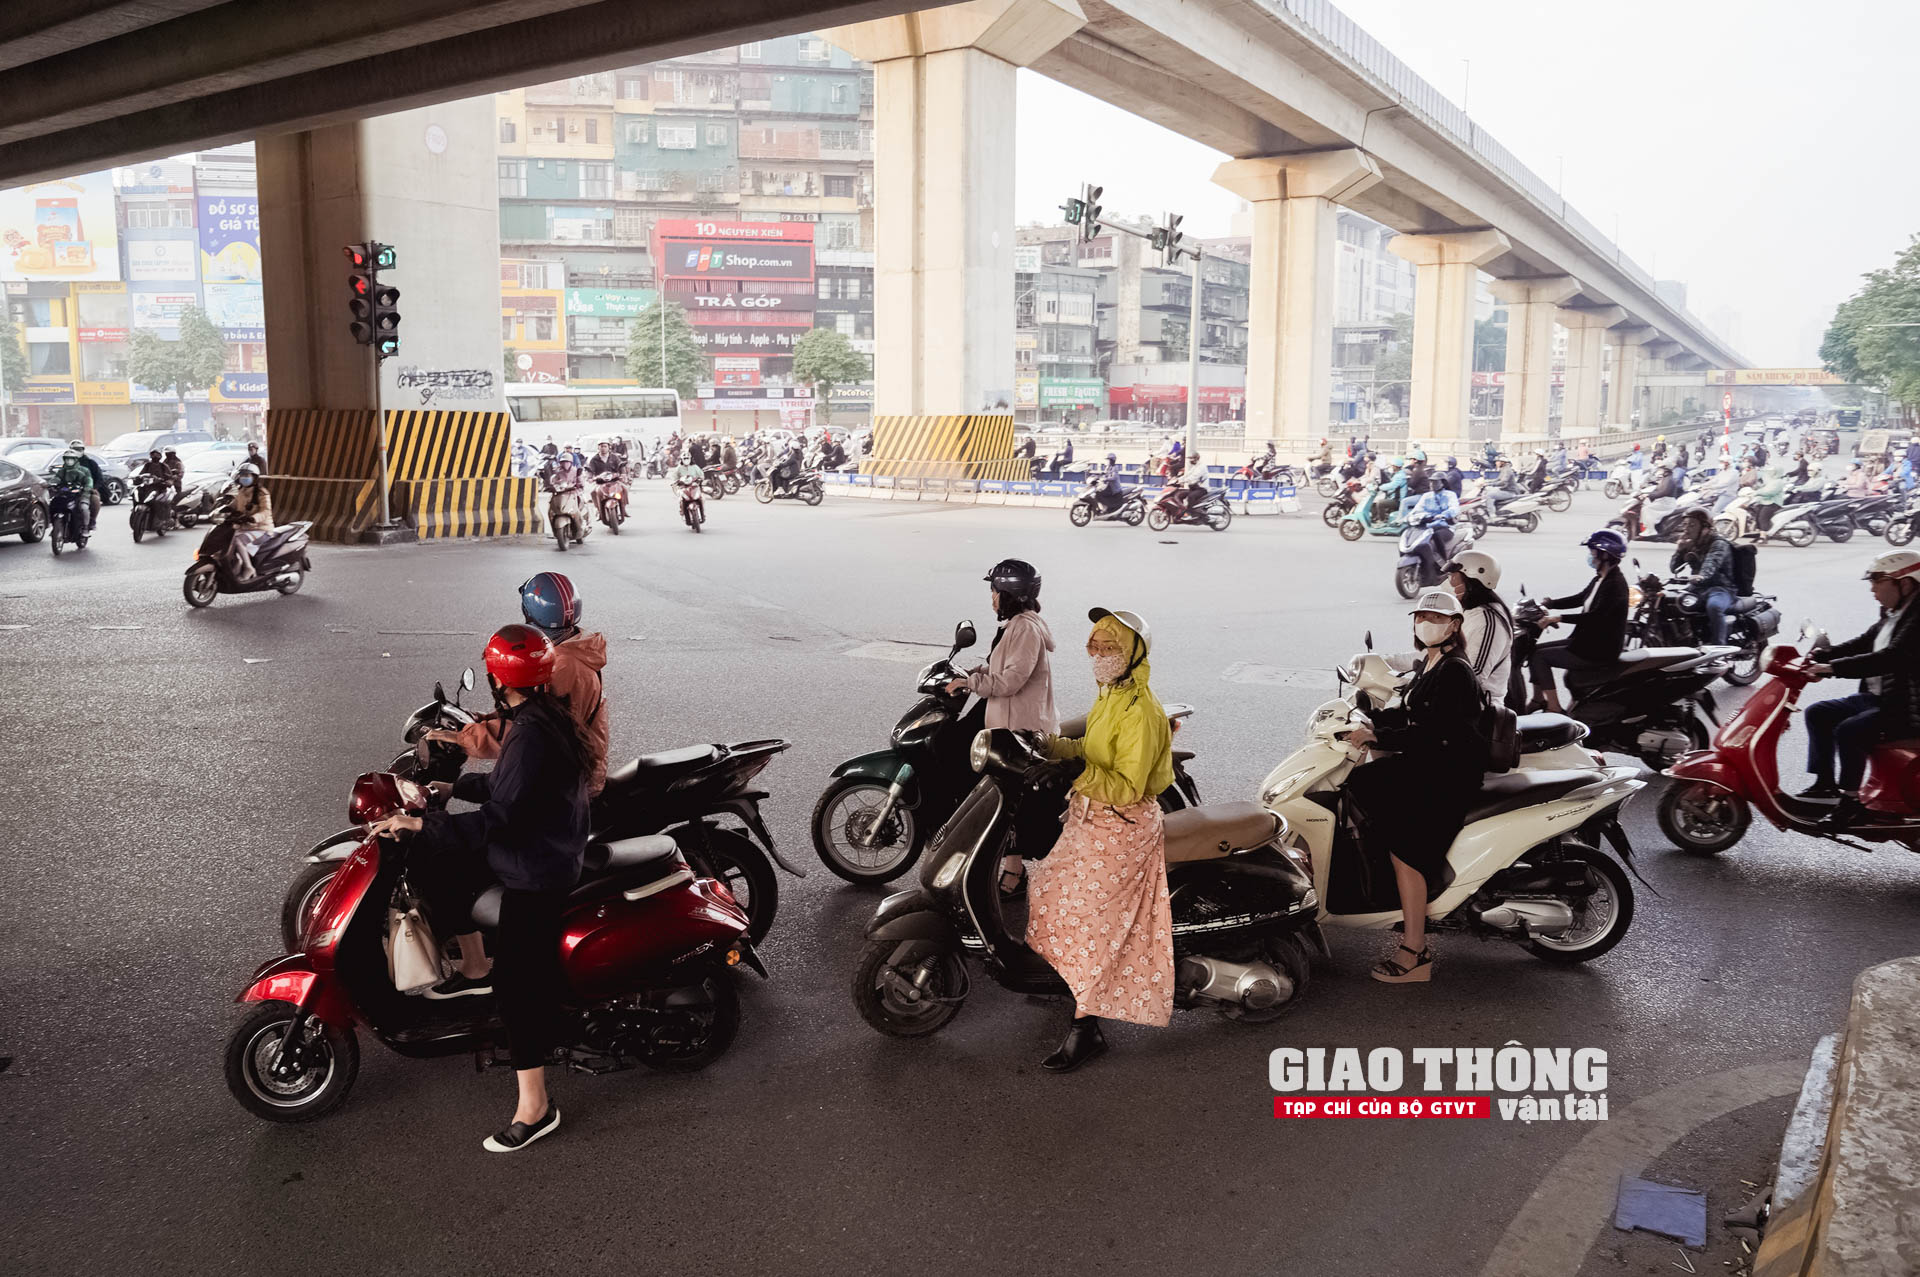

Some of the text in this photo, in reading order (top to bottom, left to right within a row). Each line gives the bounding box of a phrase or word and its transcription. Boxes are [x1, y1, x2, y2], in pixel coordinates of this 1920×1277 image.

[695, 222, 716, 236] 10
[686, 250, 793, 269] FPT Shop.com.vn
[694, 293, 782, 308] TRẢ GÓP
[714, 333, 729, 348] Máy
[729, 333, 743, 345] tính
[750, 333, 770, 348] Apple
[776, 333, 790, 348] Phụ
